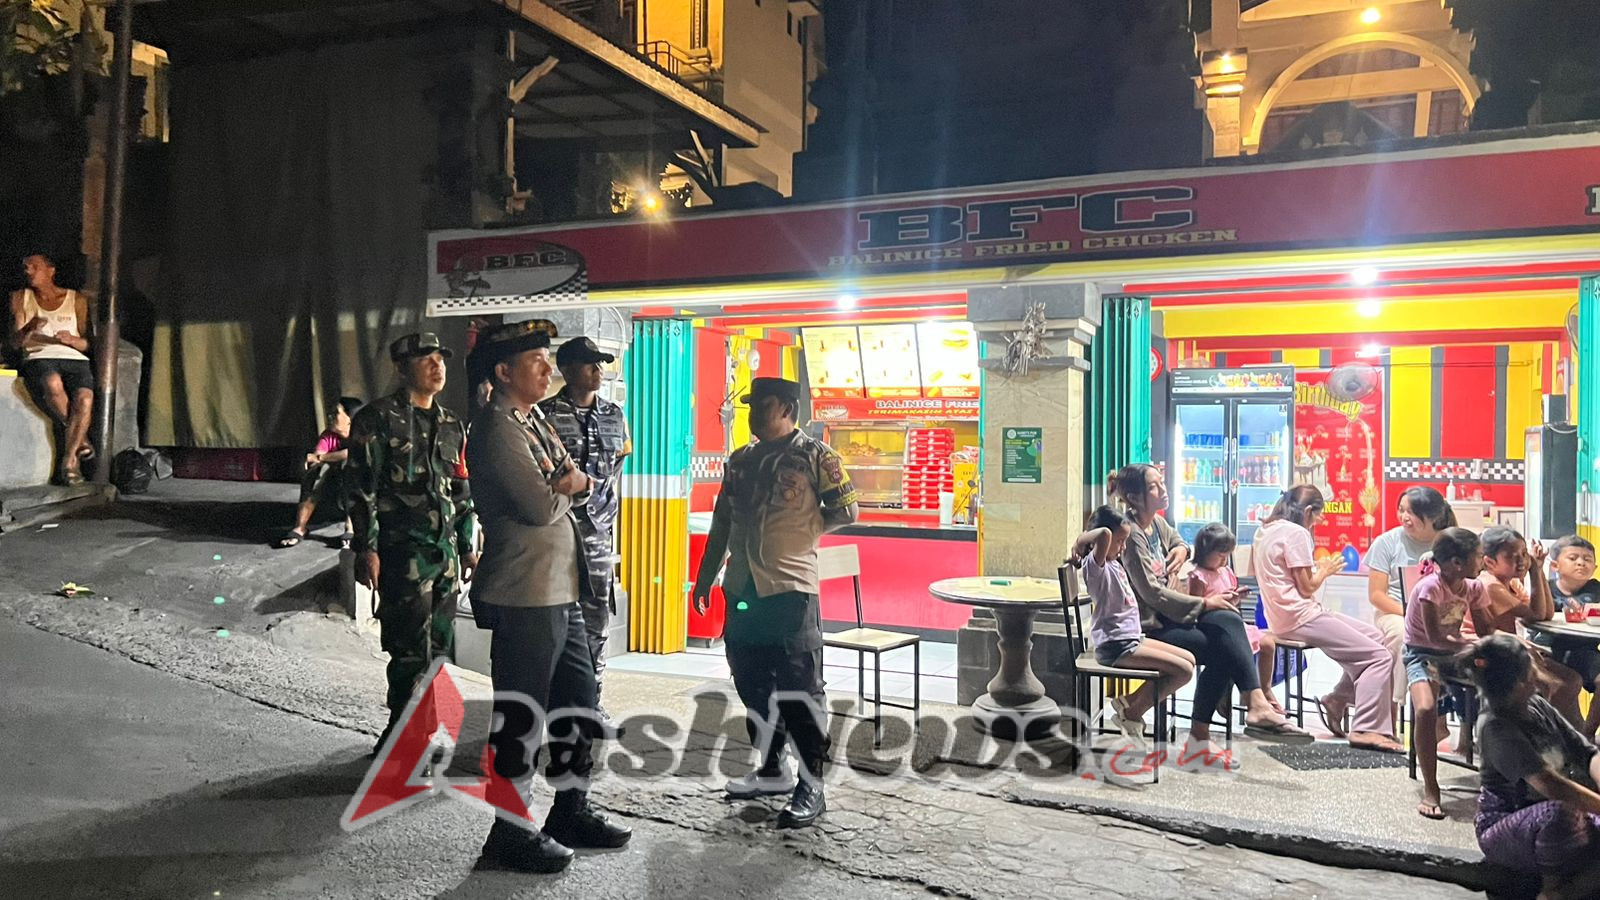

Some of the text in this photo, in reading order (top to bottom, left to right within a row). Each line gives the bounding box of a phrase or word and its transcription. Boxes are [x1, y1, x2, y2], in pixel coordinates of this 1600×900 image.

[857, 186, 1193, 251] BFC
[827, 229, 1239, 267] BALINICE FRIED CHICKEN
[483, 251, 568, 272] BFC
[876, 400, 980, 409] BALINICE FRIE
[1322, 501, 1352, 513] NGAN
